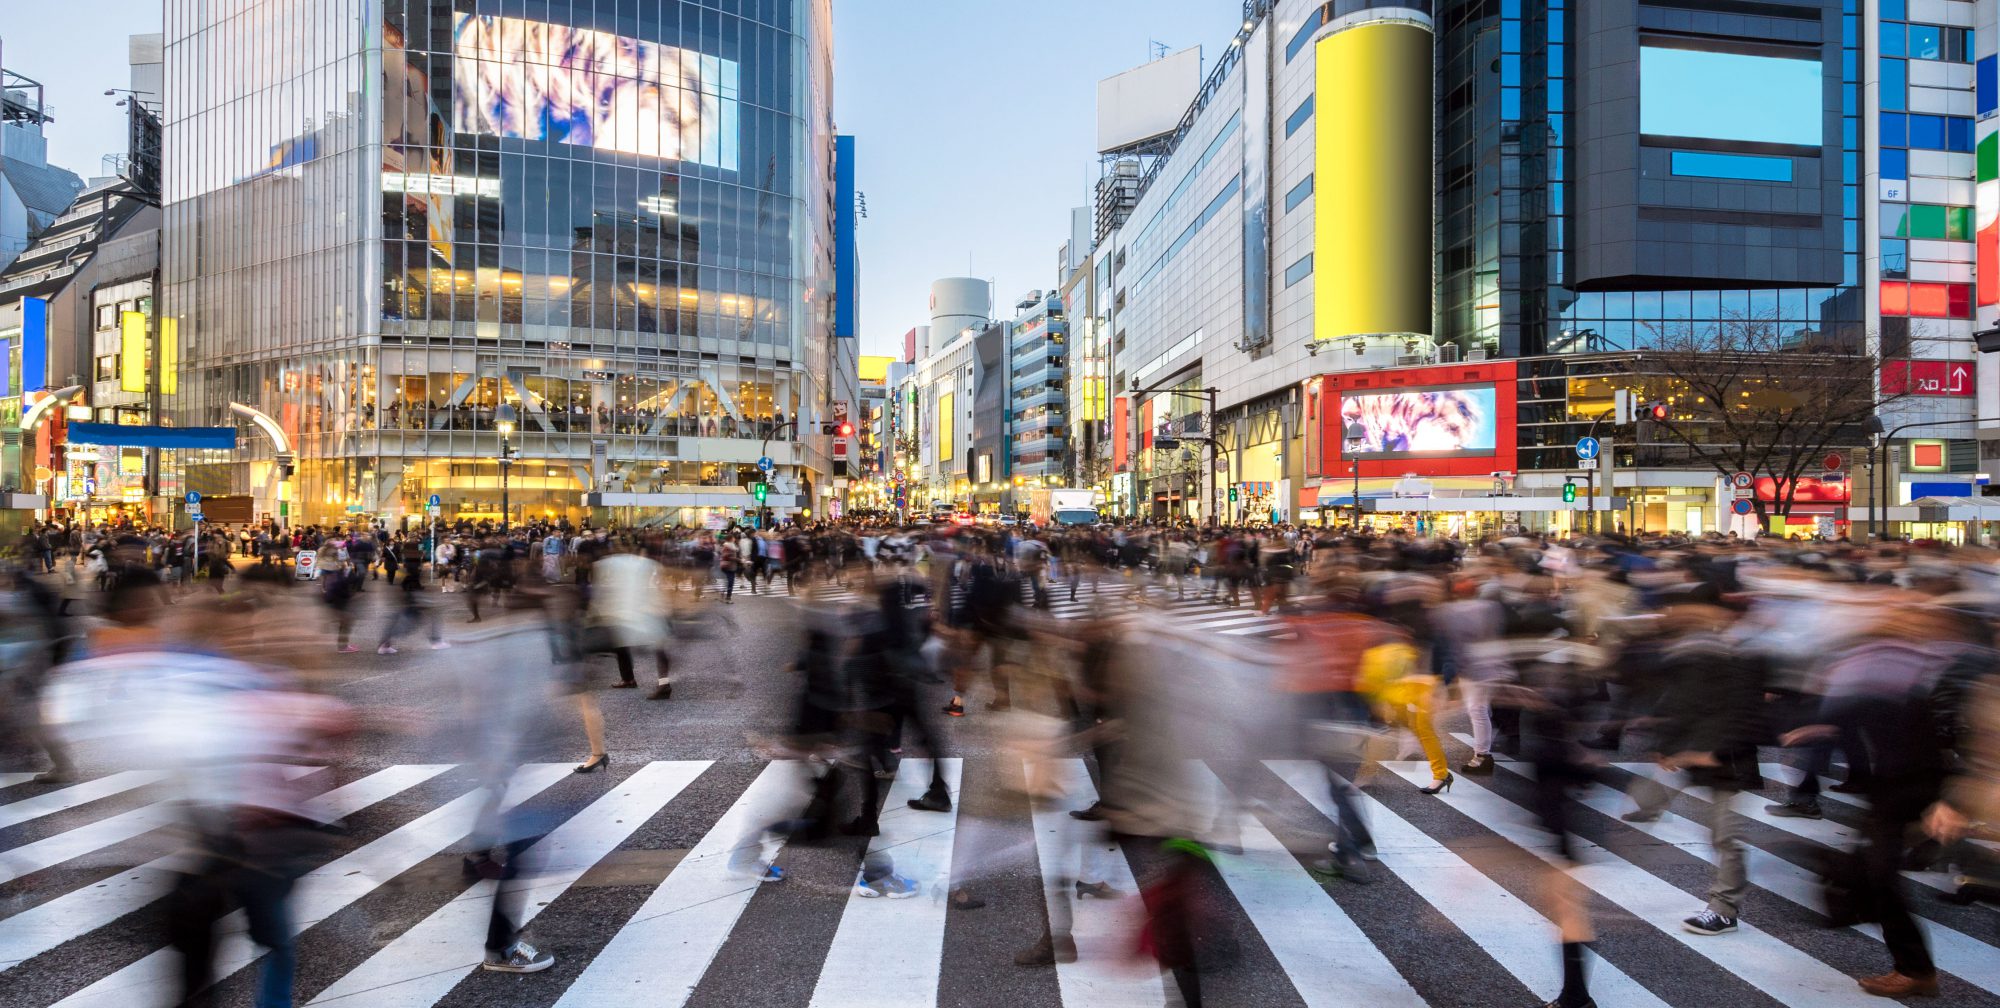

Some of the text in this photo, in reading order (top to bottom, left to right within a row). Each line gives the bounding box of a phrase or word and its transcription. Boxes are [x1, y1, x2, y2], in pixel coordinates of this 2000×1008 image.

[1983, 110, 1993, 119] 6F
[1887, 189, 1899, 198] 6F
[1919, 378, 1939, 391] 入口
